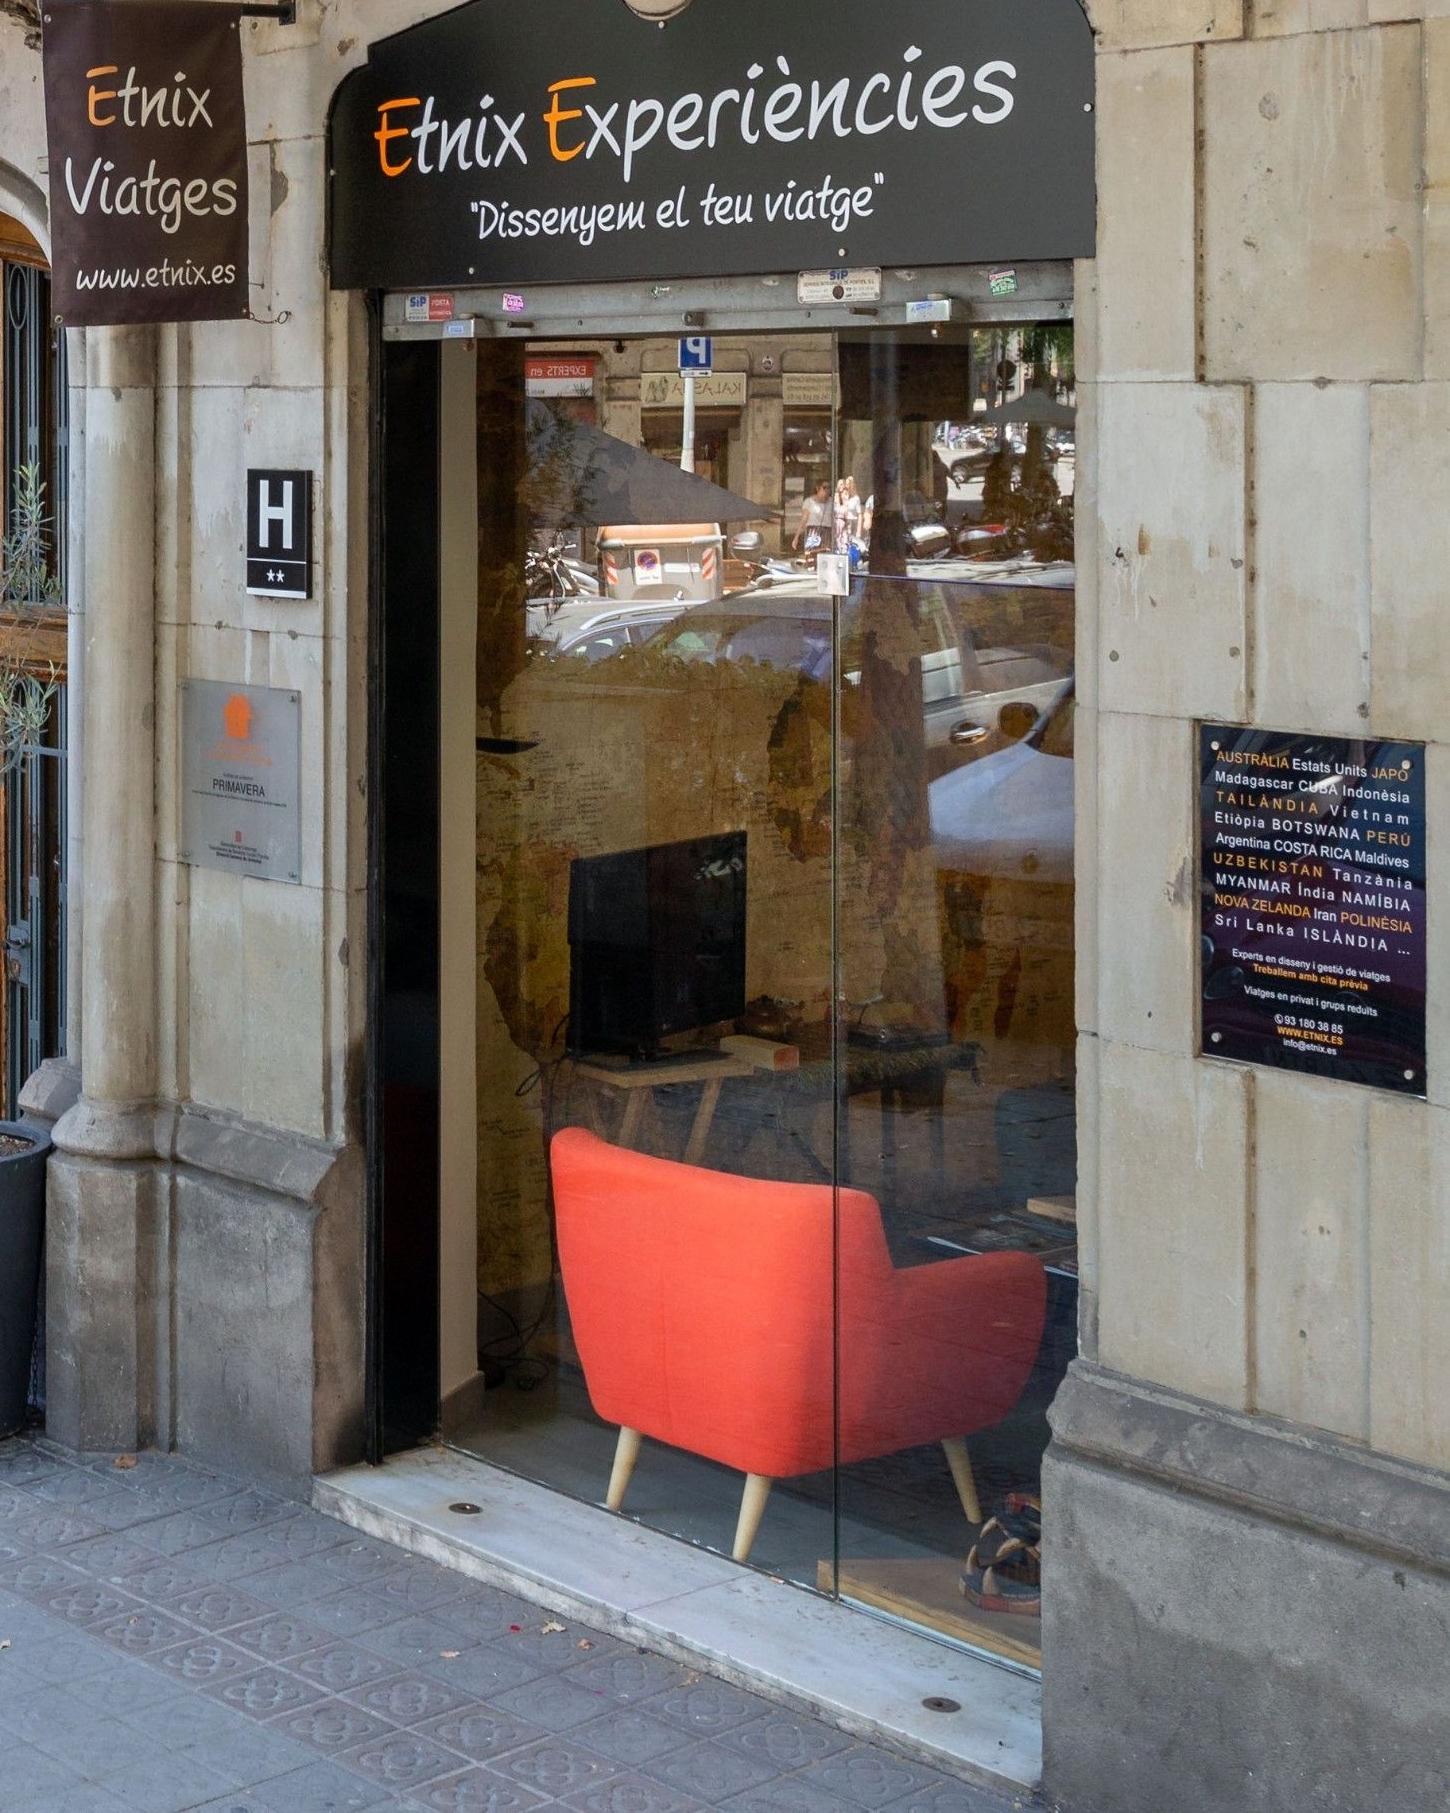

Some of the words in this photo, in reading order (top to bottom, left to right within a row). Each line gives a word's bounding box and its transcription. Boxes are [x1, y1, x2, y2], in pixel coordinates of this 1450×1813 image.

[85, 65, 214, 128] Etnix
[373, 93, 529, 178] Etnix
[542, 44, 1019, 183] Experiències
[64, 156, 238, 235] Viatges
[655, 185, 687, 229] el
[699, 182, 754, 227] teu
[76, 258, 237, 290] www.etnix.es
[258, 479, 293, 550] H
[1216, 750, 1289, 769] AUSTRÀLIA
[1292, 758, 1331, 774] Estats
[1335, 762, 1368, 778] Units
[212, 778, 265, 797] PRIMAVERA
[1215, 770, 1293, 791] Madagascar
[1299, 780, 1338, 796] CUBA
[1343, 785, 1410, 804] Indonèsia
[1216, 791, 1318, 815] TAILÀNDIA
[1330, 804, 1409, 825] Vietnam
[1215, 811, 1265, 829] Etiòpia
[1272, 819, 1360, 841] BOTSWANA
[1366, 830, 1411, 847] PERÚ
[1216, 832, 1270, 850] Argentina
[1274, 840, 1317, 856] COSTA
[1320, 845, 1352, 861] RICA
[1355, 850, 1410, 869] Maldives
[1213, 852, 1323, 878] UZBEKISTAN
[1333, 867, 1413, 891] Tanzània
[1216, 873, 1291, 895] MYANMAR
[1342, 890, 1411, 912] NAMÍBIA
[1214, 893, 1250, 909] NOVA
[1252, 898, 1311, 918] ZELANDA
[1314, 907, 1337, 923] Iran
[1340, 911, 1413, 934] POLINÈSIA
[1214, 914, 1237, 928] Sri
[1246, 918, 1295, 937] Lanka
[1304, 927, 1388, 952] ISLÀNDIA
[1232, 948, 1264, 962] Experts
[1265, 955, 1277, 964] en
[1278, 957, 1310, 971] disseny
[1318, 963, 1344, 975] gestió
[1345, 968, 1357, 977] de
[1359, 970, 1391, 983] viatges
[1253, 963, 1297, 979] Treballem
[1298, 971, 1318, 983] amb
[1320, 975, 1337, 986] cita
[1244, 985, 1276, 999] Viatges
[1277, 992, 1289, 1001] en
[1290, 995, 1314, 1007] privat
[1320, 1000, 1345, 1012] grups
[1277, 1026, 1344, 1046] WWW.ETNIX.ES
[1284, 1015, 1297, 1025] 93
[1299, 1018, 1315, 1029] 180
[1331, 1023, 1344, 1034] 85
[1283, 1039, 1337, 1055] info@etnix.es
